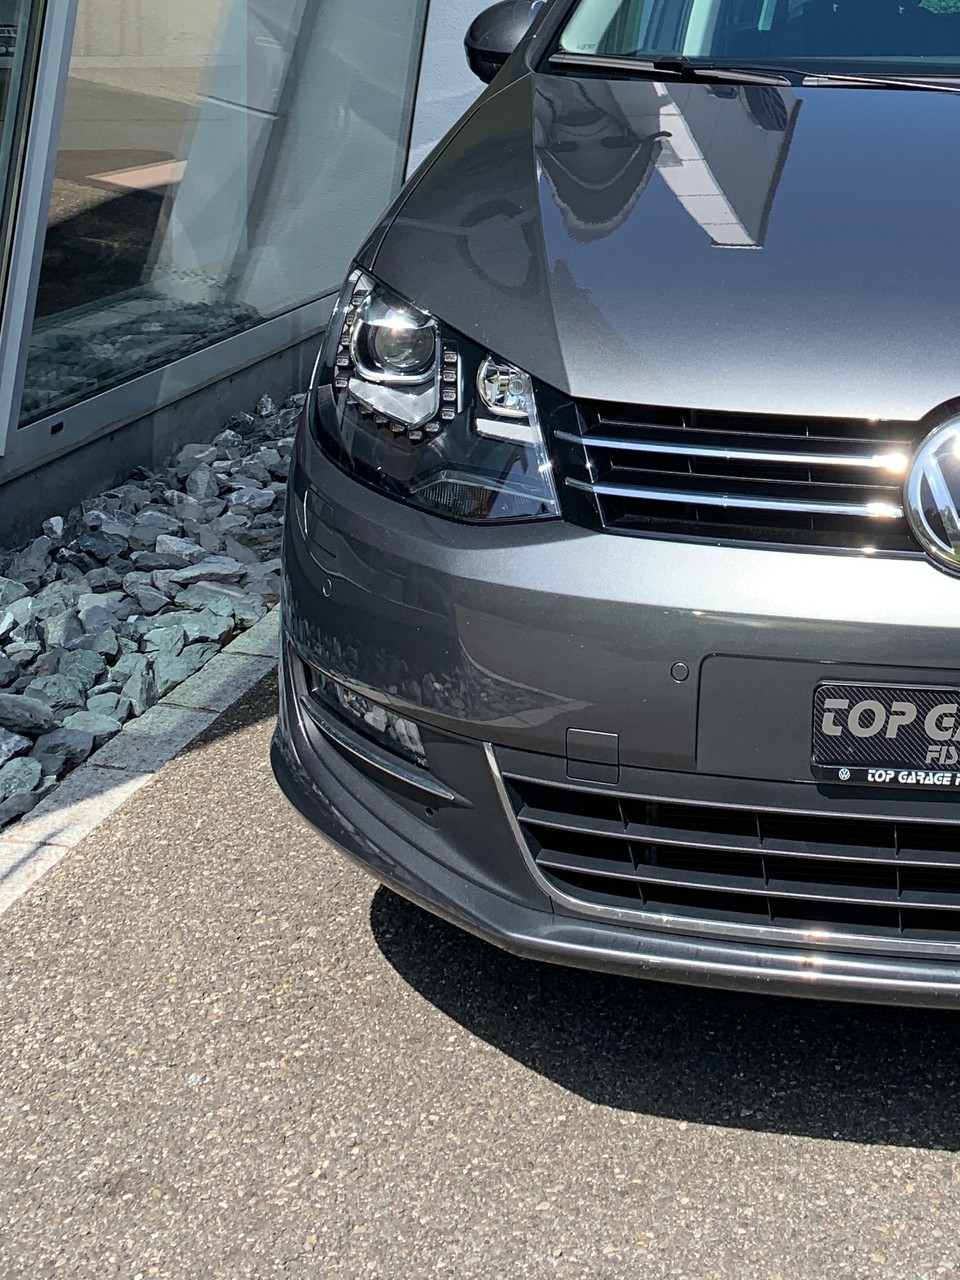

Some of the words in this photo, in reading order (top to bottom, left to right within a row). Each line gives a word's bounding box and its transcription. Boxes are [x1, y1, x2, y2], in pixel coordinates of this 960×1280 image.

[821, 698, 918, 739] TOP
[867, 769, 895, 783] TOP
[898, 770, 952, 786] GARAGE
